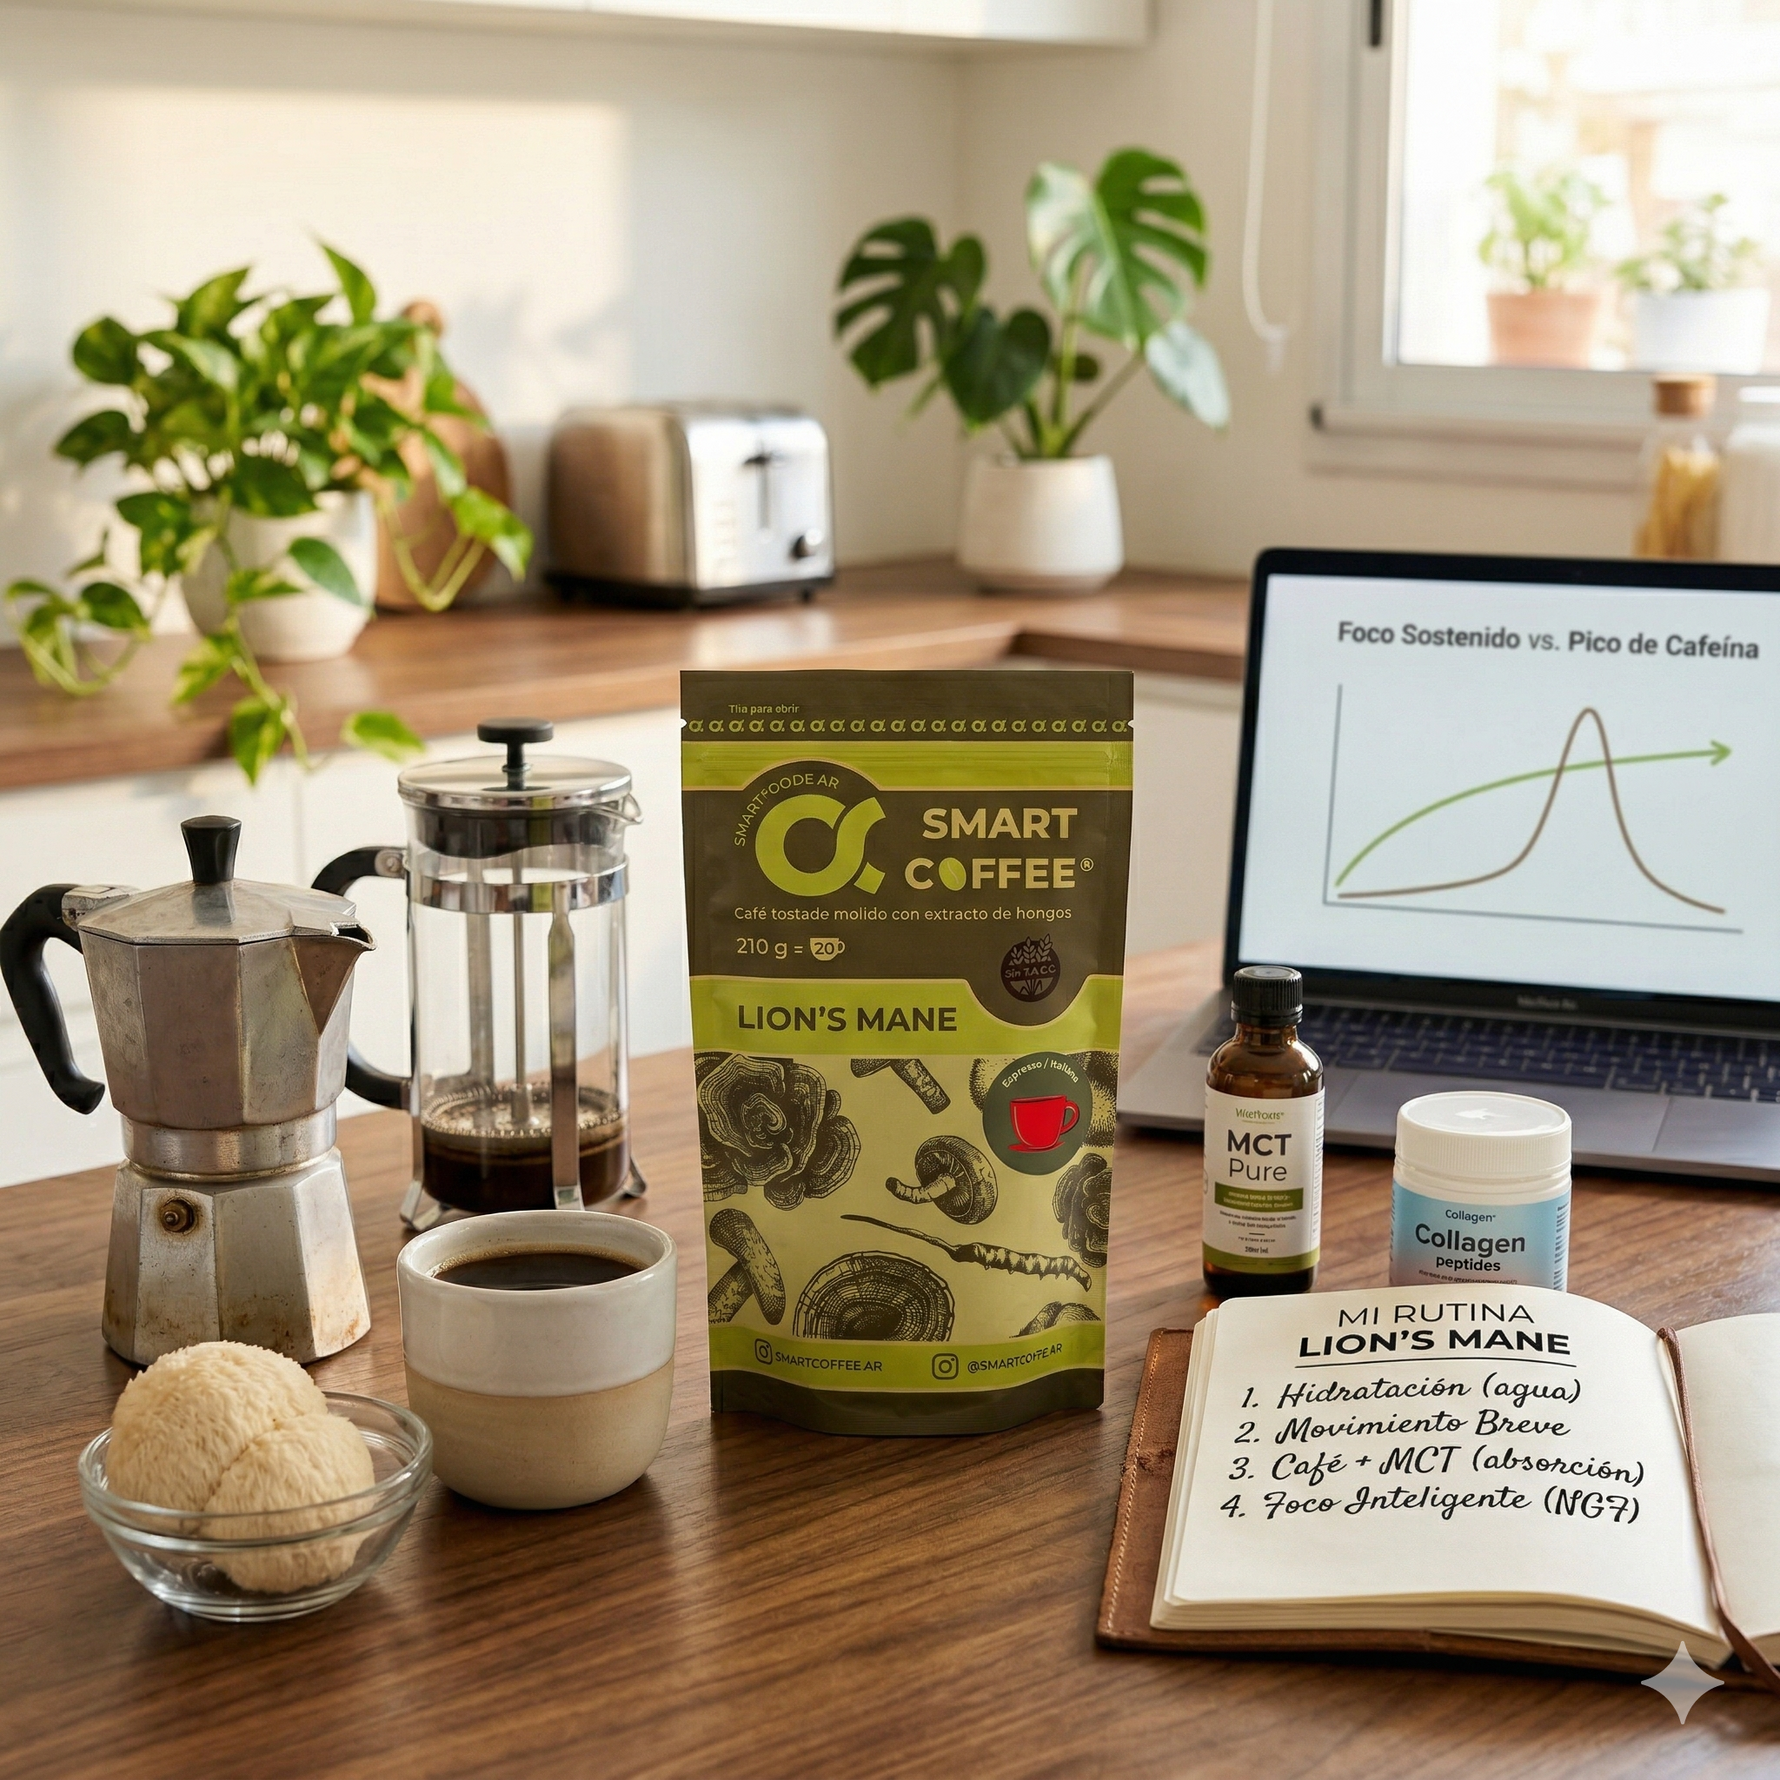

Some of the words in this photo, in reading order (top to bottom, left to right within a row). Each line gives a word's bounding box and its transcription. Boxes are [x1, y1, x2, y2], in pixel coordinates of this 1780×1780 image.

[1337, 621, 1396, 645] Foco
[1401, 623, 1520, 650] Sostenido
[1528, 631, 1560, 651] vs.
[1568, 630, 1622, 653] Pico
[1628, 632, 1658, 656] de
[1665, 634, 1760, 660] Cafeína
[750, 705, 773, 716] para
[922, 807, 1078, 839] SMART
[734, 906, 767, 920] Café
[771, 906, 830, 921] tostade
[833, 905, 888, 921] molido
[891, 908, 920, 921] con
[924, 907, 988, 921] extracto
[992, 906, 1012, 920] de
[1016, 906, 1072, 922] hongos
[736, 937, 769, 955] 210
[774, 941, 788, 959] g
[815, 942, 835, 955] 20
[1004, 968, 1021, 978] Sin
[738, 1005, 847, 1031] LION'S
[857, 1006, 958, 1032] MANE
[1227, 1129, 1292, 1156] MCT
[1229, 1157, 1287, 1181] Pure
[1415, 1223, 1525, 1258] Collagen
[1436, 1256, 1501, 1272] peptides
[1338, 1306, 1379, 1328] MI
[1394, 1303, 1535, 1324] RUTINA
[1299, 1330, 1435, 1357] LION'S
[1449, 1329, 1571, 1355] MANE
[1241, 1387, 1259, 1408] 1.
[1276, 1377, 1472, 1409] Hidratación
[1482, 1372, 1581, 1408] (agua)
[1234, 1421, 1260, 1444] 2.
[1274, 1411, 1469, 1444] Movimiento
[1475, 1409, 1571, 1436] Breve
[1228, 1457, 1255, 1480] 3.
[1271, 1451, 1348, 1487] Café
[1355, 1455, 1372, 1467] +
[1379, 1446, 1462, 1475] MCT
[1472, 1445, 1644, 1487] (absorción)
[1219, 1494, 1246, 1518] 4.
[1344, 1486, 1532, 1521] Inteligente
